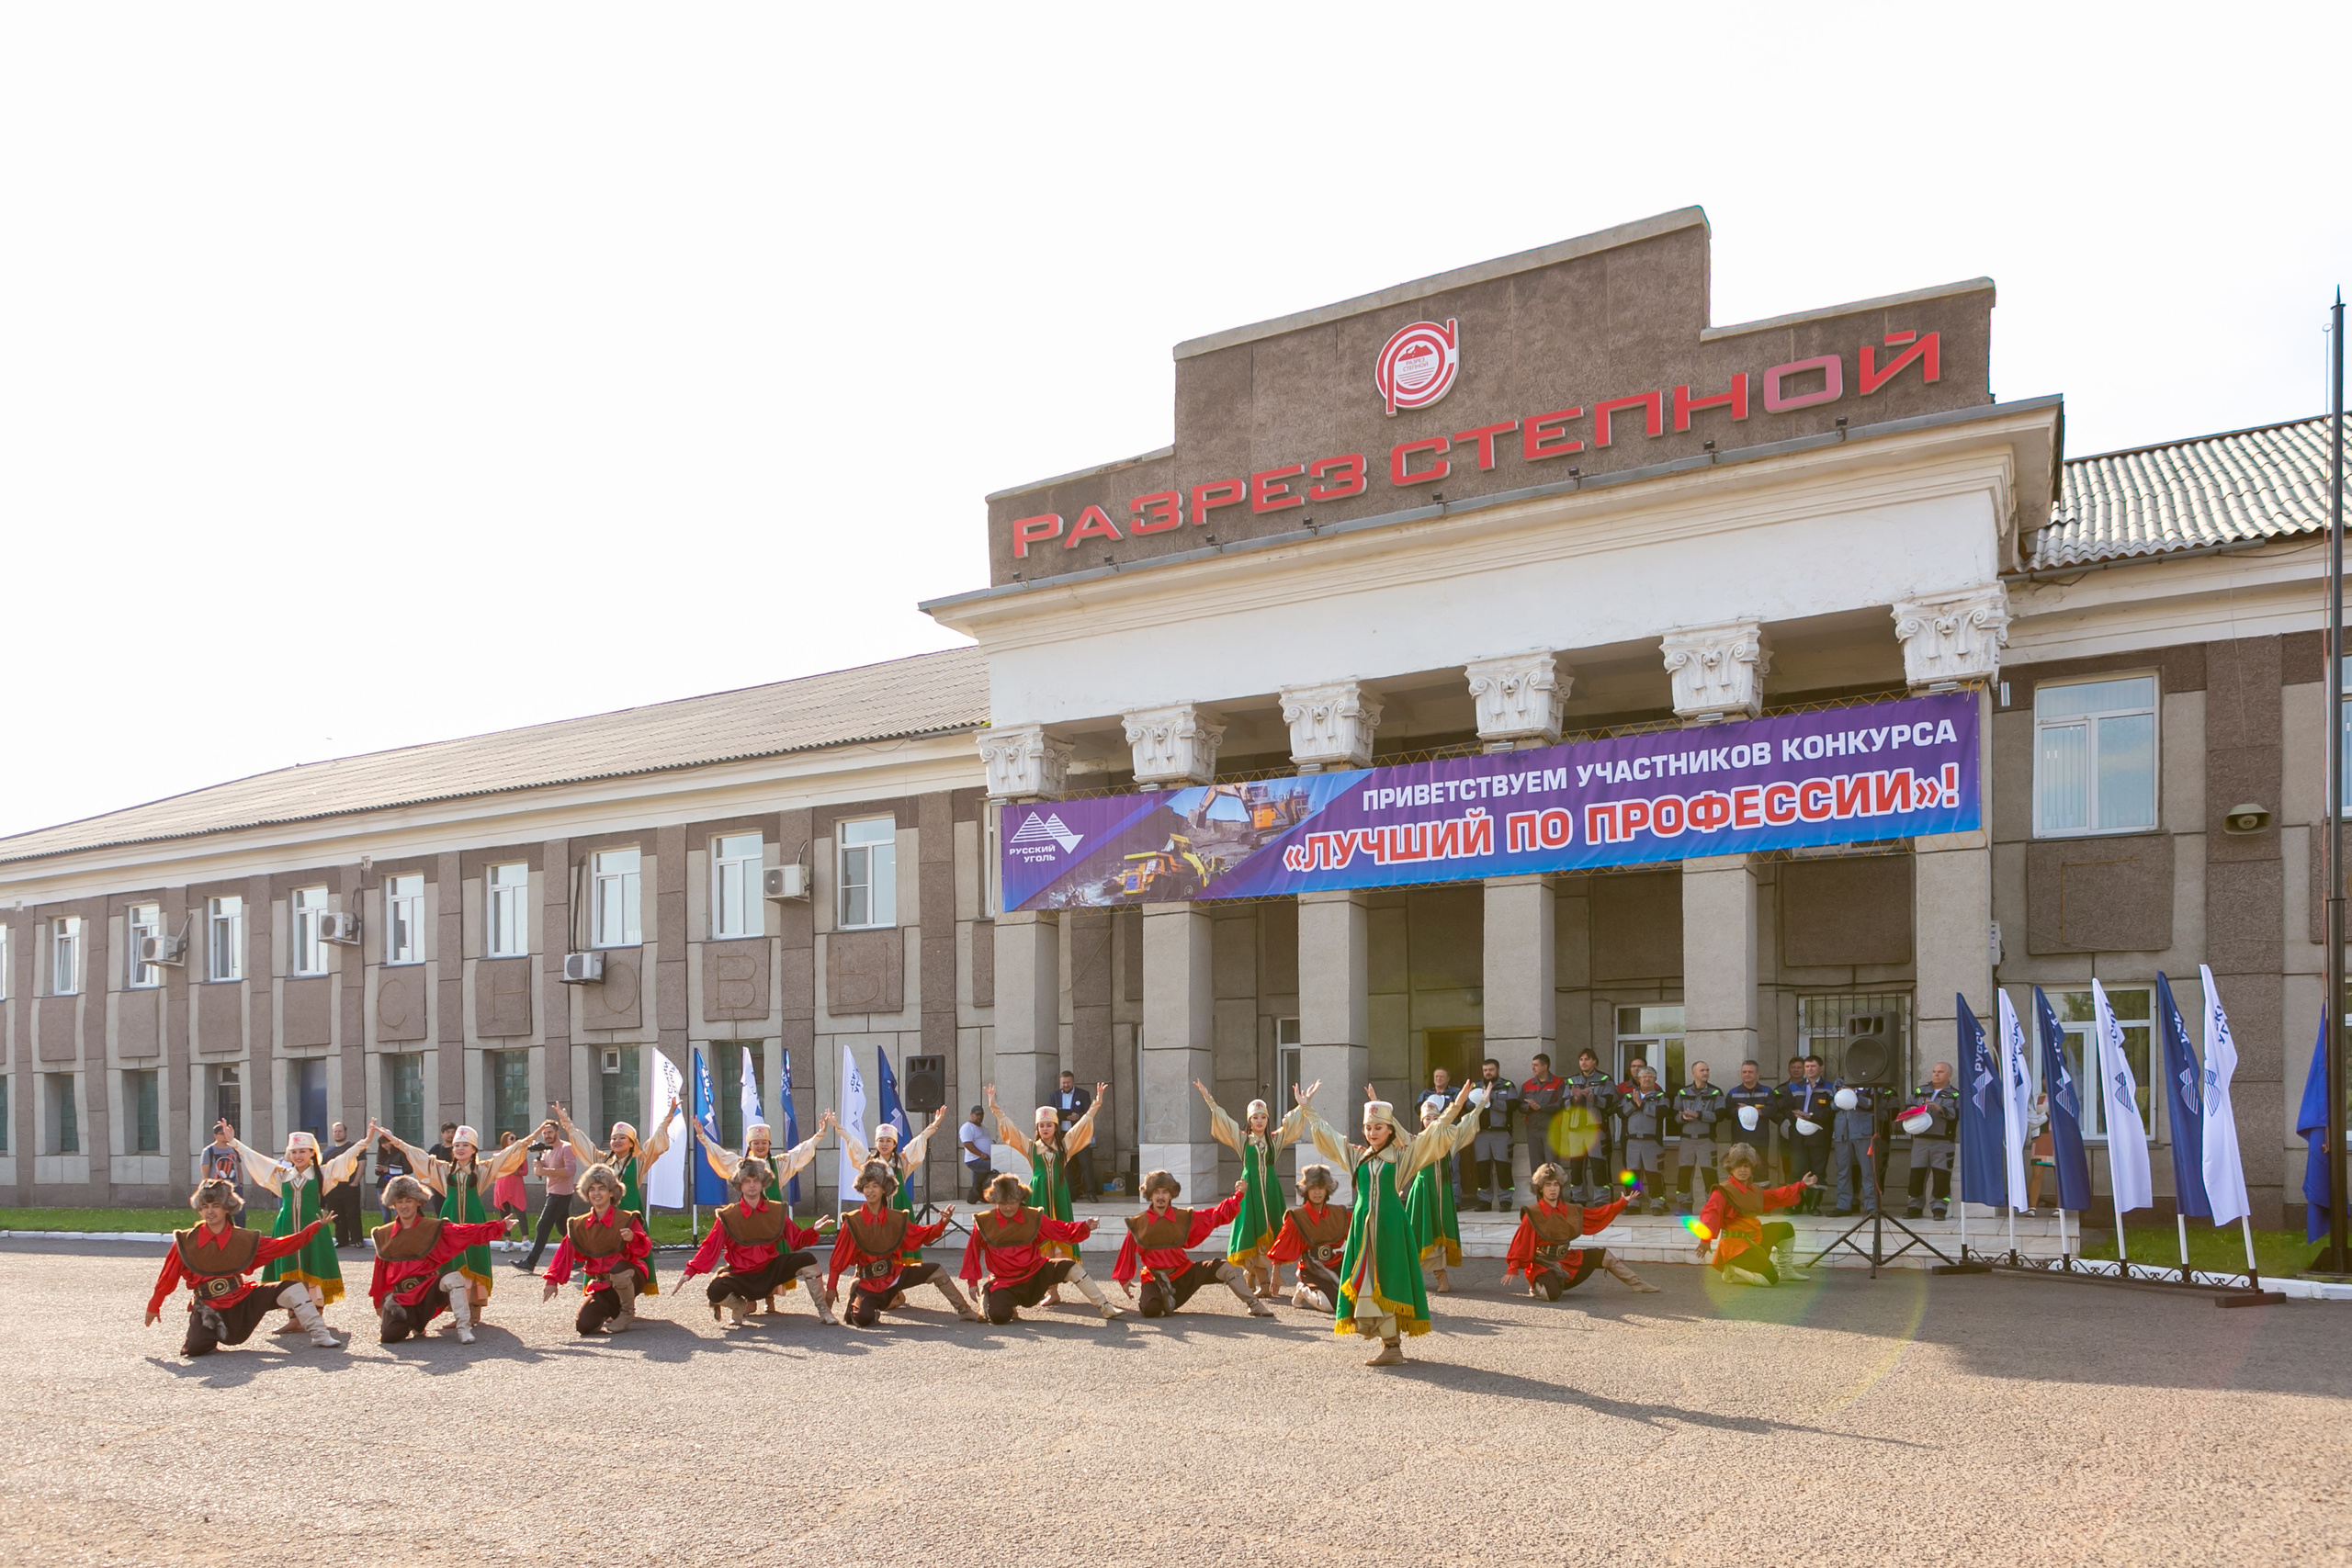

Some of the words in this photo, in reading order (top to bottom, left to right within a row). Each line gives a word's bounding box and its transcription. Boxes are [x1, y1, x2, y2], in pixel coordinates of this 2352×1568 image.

[1403, 362, 1429, 372] СТЕПНОЙ
[1406, 357, 1426, 366] РАЗРЕЗ
[1012, 452, 1369, 558] РАЗРЕЗ
[1390, 330, 1942, 487] СТЕПНОЙ
[1363, 767, 1567, 811] ПРИВЕТСТВУЕМ
[1577, 741, 1771, 787] УЧАСТНИКОВ
[1781, 718, 1958, 762] КОНКУРСА
[1283, 807, 1494, 872] «ЛУЧШИЙ
[1507, 808, 1573, 852] ПО
[1586, 762, 1959, 845] ПРОФЕССИИ»!
[1009, 844, 1056, 855] РУССКИЙ
[1023, 854, 1056, 863] УГОЛЬ
